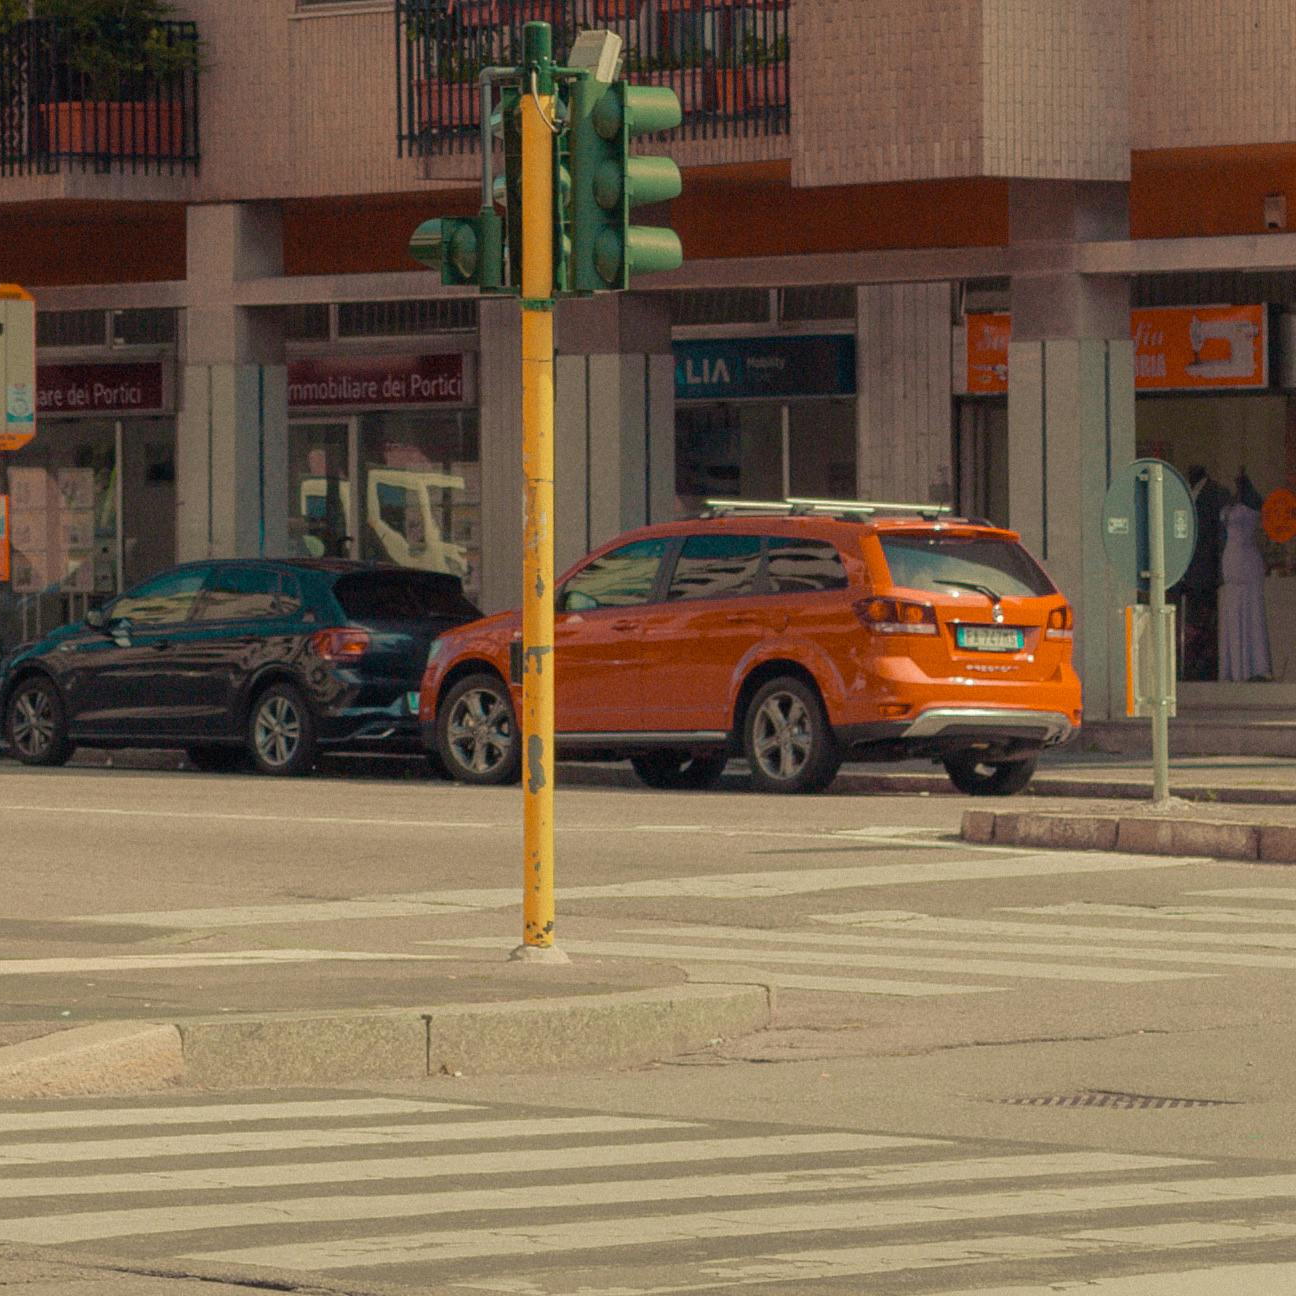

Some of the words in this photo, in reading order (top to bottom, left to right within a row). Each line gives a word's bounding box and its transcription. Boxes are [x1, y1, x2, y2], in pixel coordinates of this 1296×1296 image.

[67, 383, 89, 406] dei
[93, 382, 141, 405] Portici
[382, 374, 405, 398] dei
[410, 372, 462, 397] Portici
